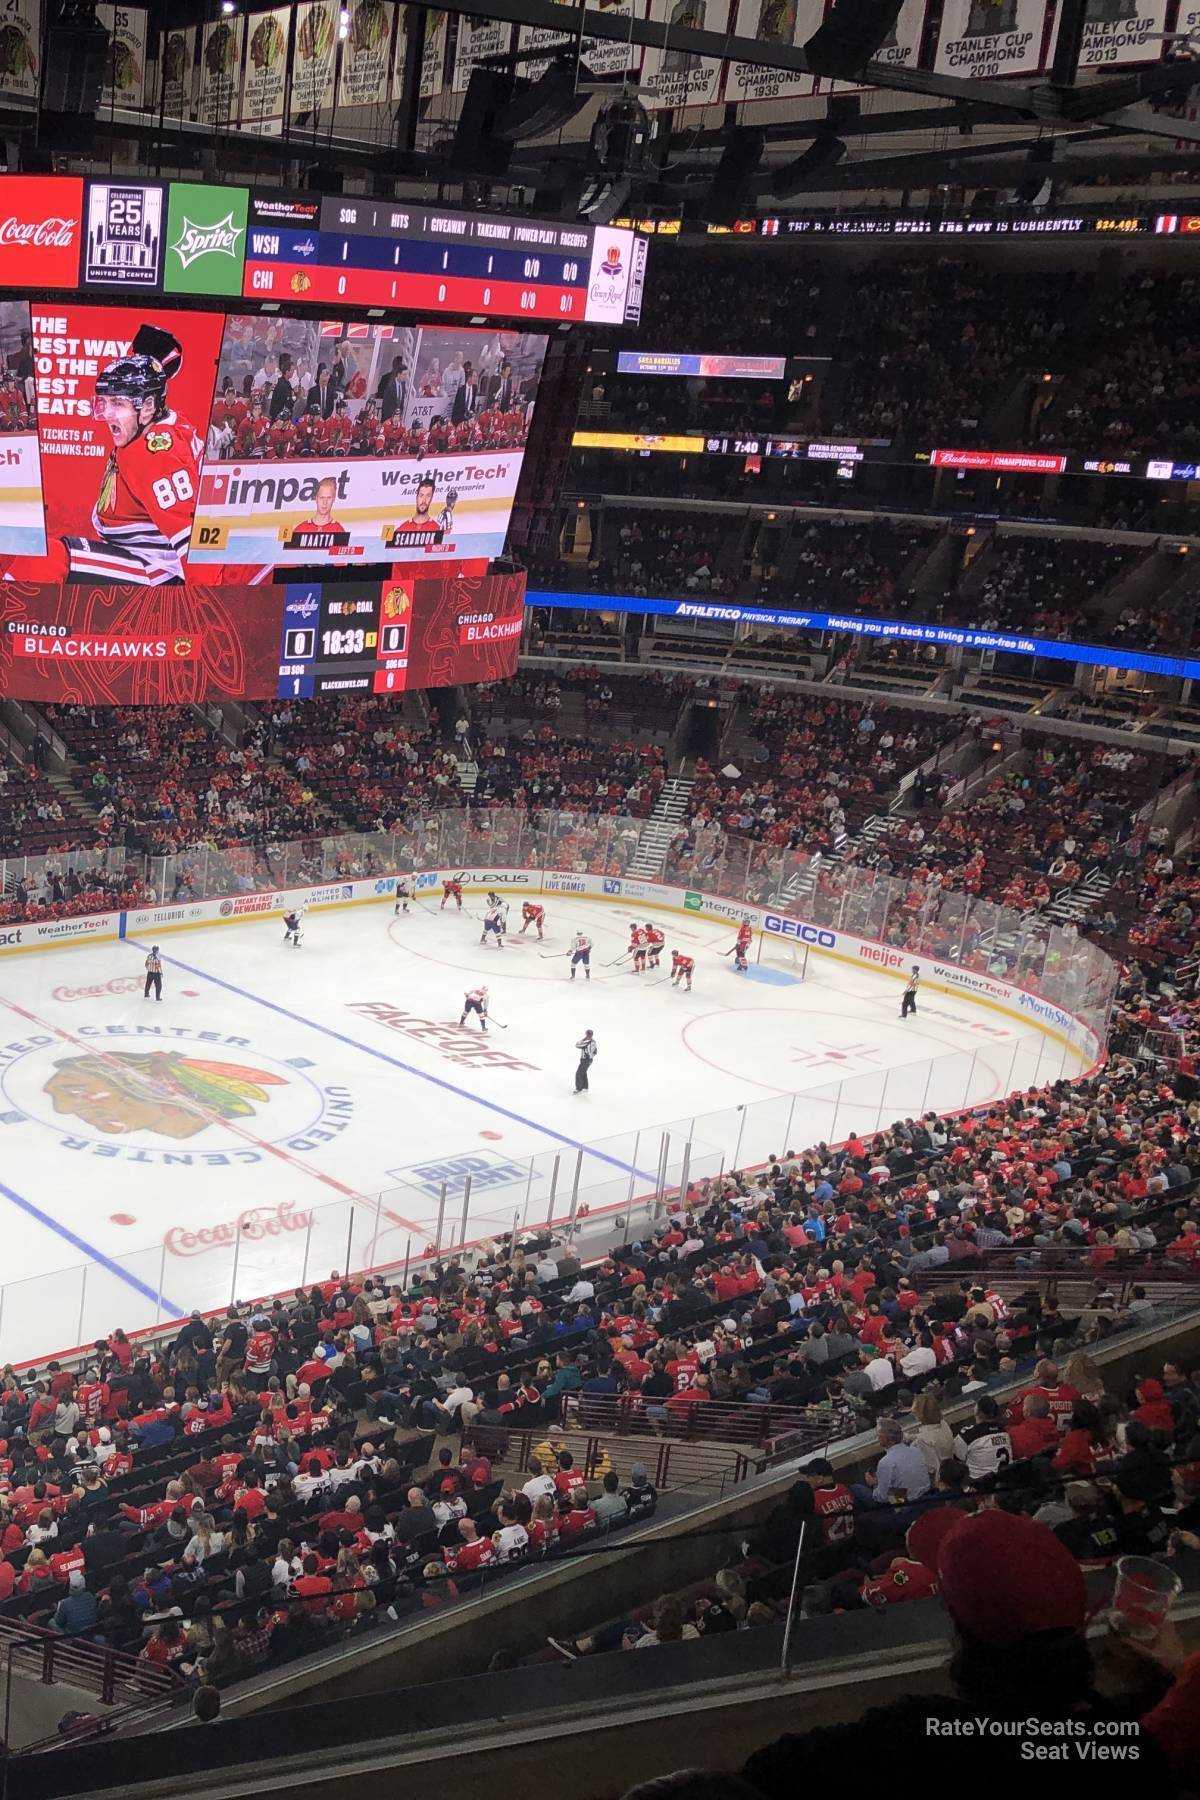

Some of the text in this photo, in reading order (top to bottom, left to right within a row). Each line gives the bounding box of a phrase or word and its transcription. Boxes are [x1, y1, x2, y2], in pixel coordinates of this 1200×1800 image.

[461, 41, 505, 56] BLACKHAWKS
[945, 32, 1033, 55] STANLEY CUP
[588, 43, 631, 61] CHAMPIONS
[887, 48, 912, 61] CUP
[949, 47, 1026, 66] CHAMPIONS
[1086, 48, 1118, 63] 2013
[590, 59, 628, 74] 2016-2017
[970, 64, 999, 78] 2010
[647, 69, 715, 86] STANLEY CUP
[738, 72, 801, 88] CHAMPIONS
[754, 85, 780, 97] 1938
[664, 95, 688, 106] 1934
[110, 200, 142, 225] 25
[254, 200, 318, 214] WeatherTech
[109, 225, 141, 237] YEARS
[339, 208, 588, 248] SOG HITS GIVEAWAY TAKEAWAY POWER PLAY FACEOFFS
[181, 228, 233, 251] Sprite
[253, 234, 578, 282] WSH 1 1 1 1 0/0 0/0
[90, 269, 154, 279] UNITED CENTER
[253, 270, 574, 313] CHI 0 1 0 0 0/0 0/1
[32, 317, 68, 335] THE
[411, 405, 434, 417] AT&T
[43, 428, 94, 442] TICKETS AT
[734, 440, 759, 454] 7:40
[939, 452, 1057, 469] Budweiser CHAMPIONS CLUB
[151, 469, 195, 511] 88
[228, 463, 508, 511] impat WeatherTech
[199, 527, 221, 546] D2
[300, 533, 335, 547] MAATTA
[394, 531, 437, 546] SEABROOK
[328, 602, 343, 615] ONE
[355, 600, 374, 614] GOAL
[675, 602, 812, 627] ATHLETICO PHYSICAL THERAPY
[458, 612, 494, 625] CHICAGO
[8, 621, 68, 637] CHICAGO
[827, 617, 1036, 651] Helping you get back to living a pain-free life.
[25, 637, 168, 658] BLACKHAWKS
[472, 873, 529, 883] LEXUS
[545, 879, 587, 893] LIVE GAMES
[234, 894, 274, 907] FREAKY FAST
[303, 893, 340, 904] AIRLINES
[311, 887, 340, 898] UNITED
[153, 909, 186, 923] TELLURIDE
[233, 901, 273, 915] REWARDS
[37, 919, 109, 936] WeatherTech
[764, 914, 837, 948] GEICO
[859, 943, 904, 968] meijer
[933, 965, 1012, 999] WeatherTech
[77, 1024, 252, 1048] CENTER
[344, 1001, 543, 1072] FACE-OFF
[59, 1086, 354, 1166] UNITED CENTER
[411, 1157, 490, 1182] BUD
[163, 1200, 310, 1258] Coca-Cola
